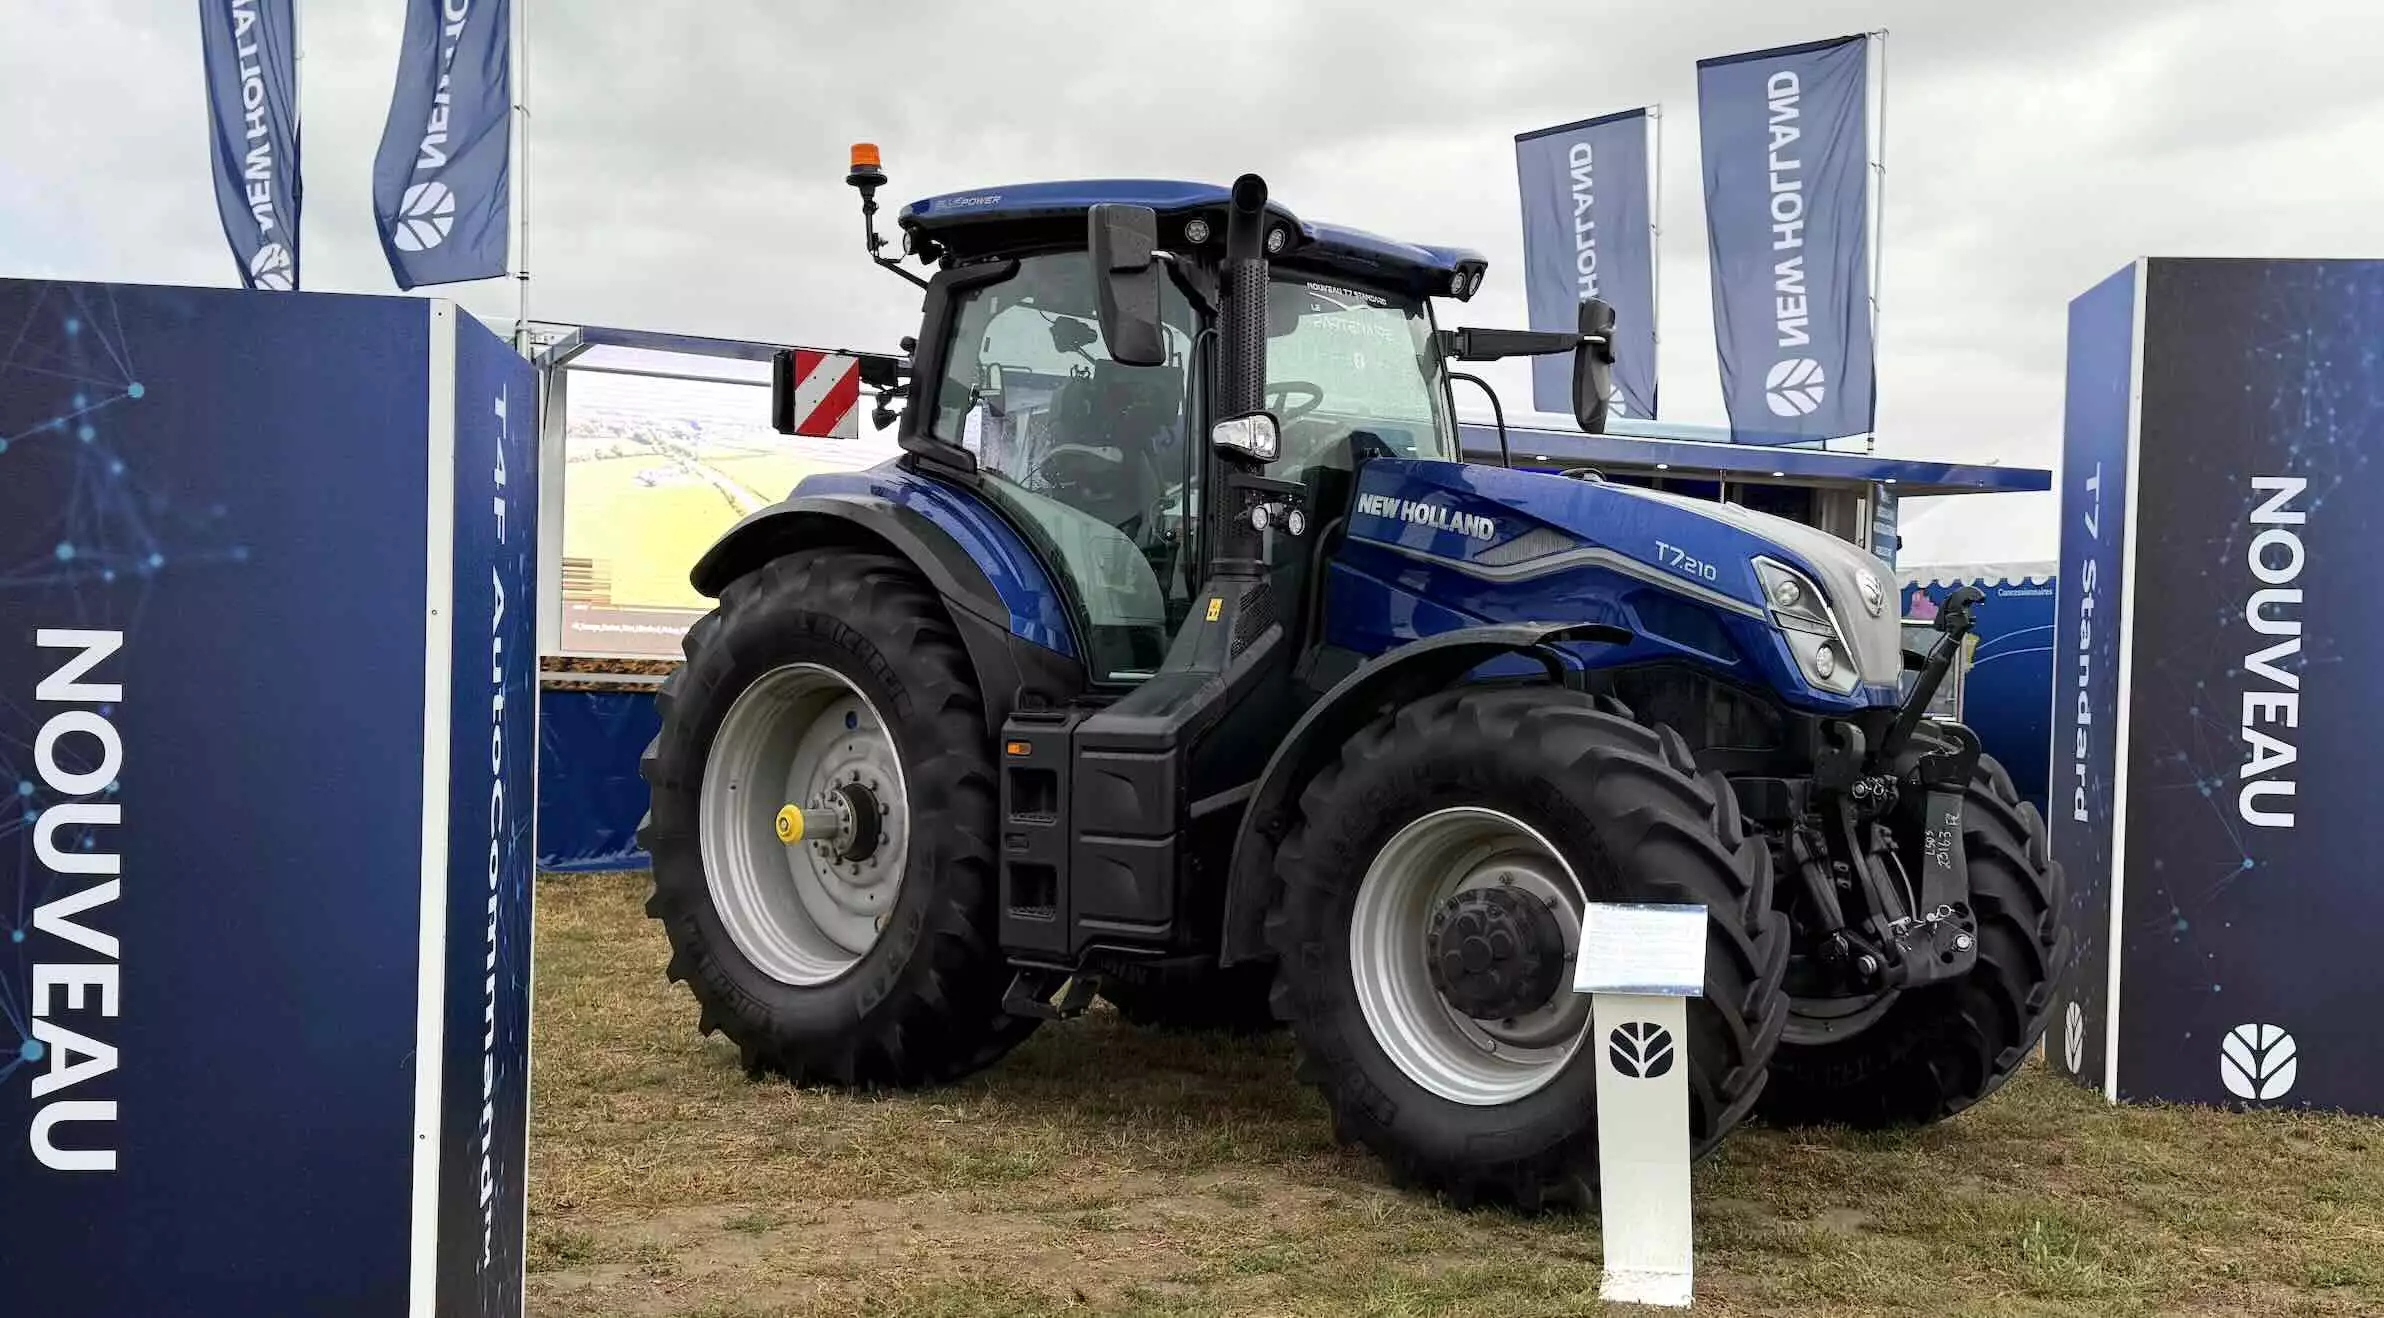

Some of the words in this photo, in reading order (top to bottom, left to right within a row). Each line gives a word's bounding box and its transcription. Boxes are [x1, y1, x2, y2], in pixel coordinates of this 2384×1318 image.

[493, 383, 507, 546] T4F
[1357, 493, 1401, 519] NEW
[1400, 500, 1496, 541] HOLLAND
[2084, 461, 2101, 540] T7
[1655, 540, 1717, 582] T7.210
[2074, 559, 2097, 823] Standard
[2238, 476, 2307, 828] NOUVEAU
[29, 628, 124, 1171] NOUVEAU
